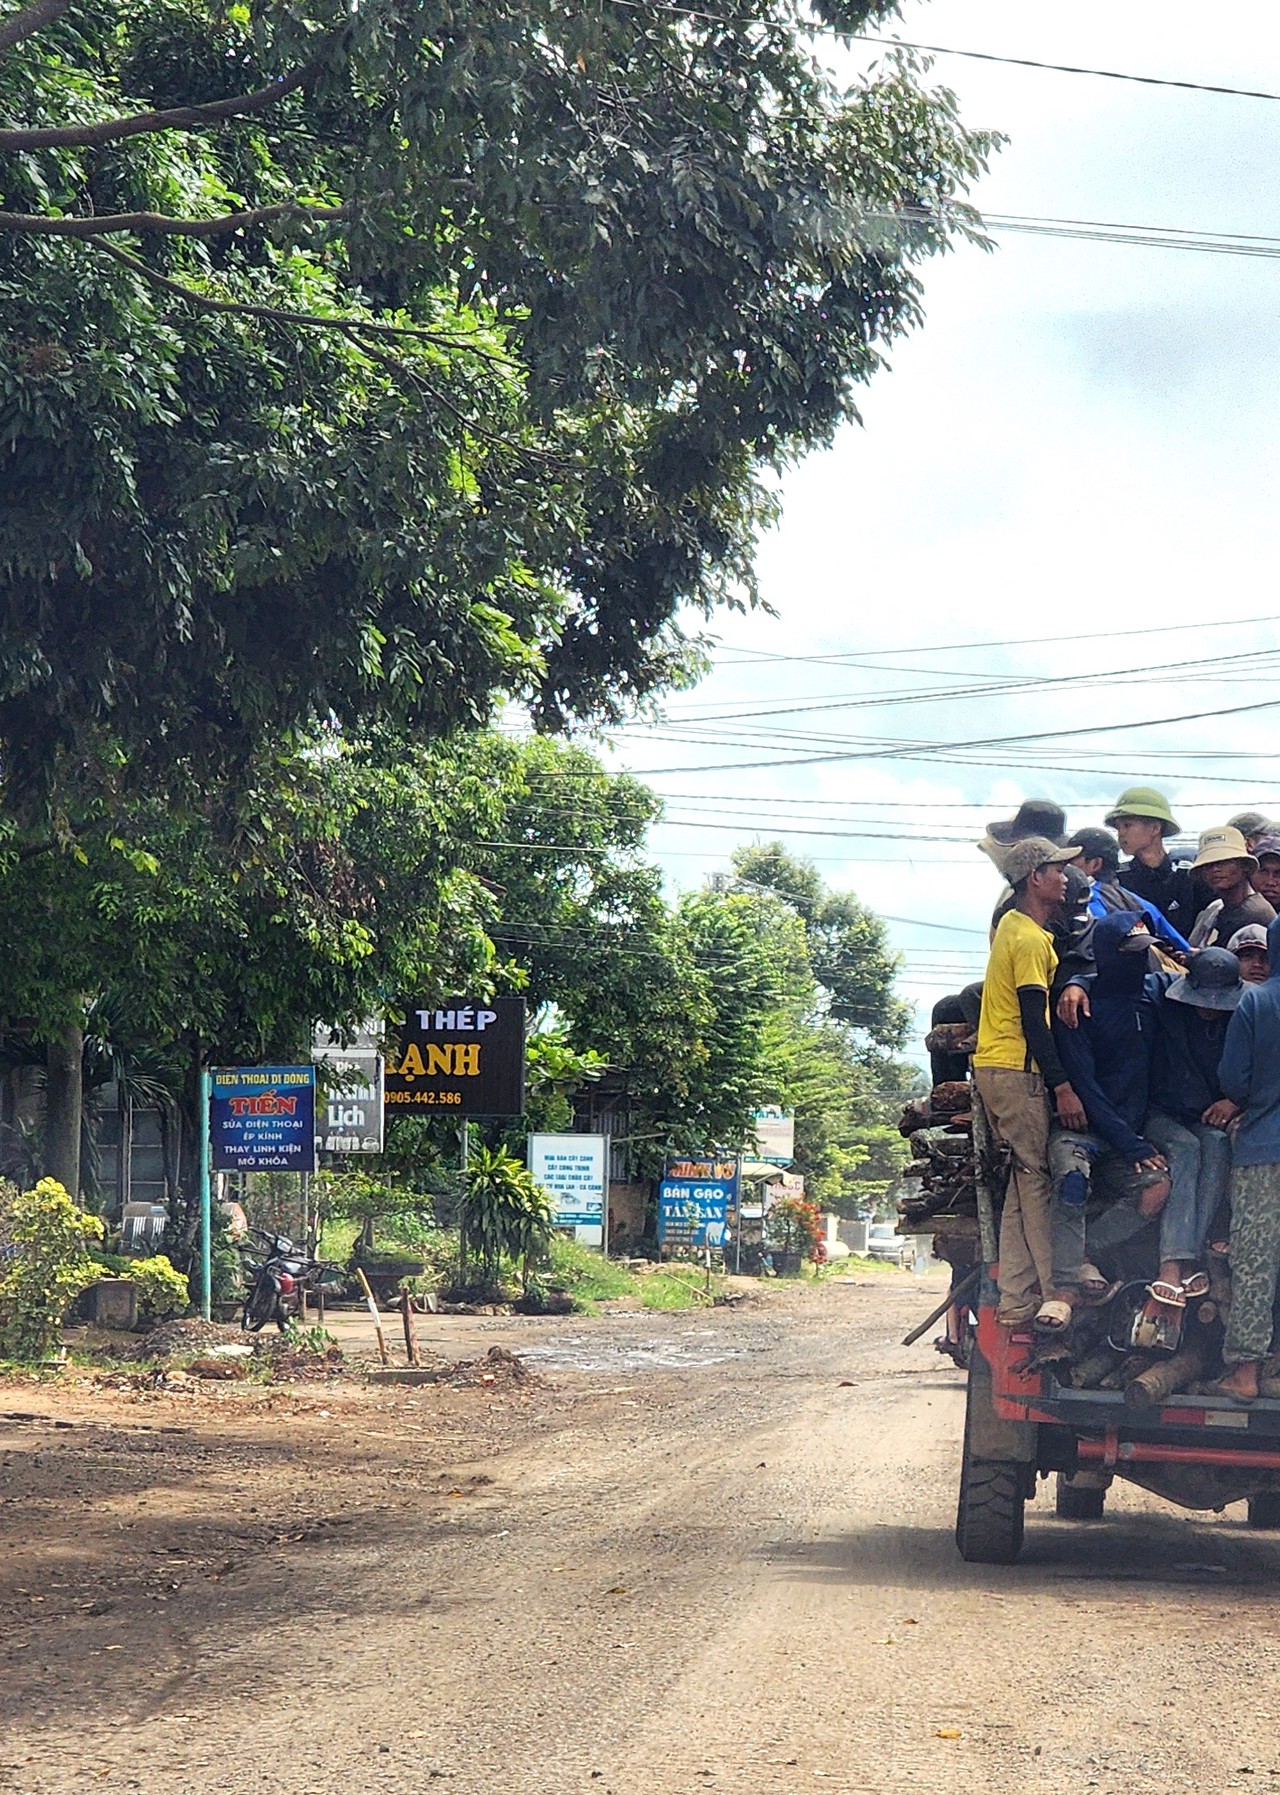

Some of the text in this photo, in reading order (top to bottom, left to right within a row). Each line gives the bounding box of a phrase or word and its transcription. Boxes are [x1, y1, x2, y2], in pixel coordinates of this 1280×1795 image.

[415, 1005, 498, 1030] THÉP
[228, 1089, 298, 1116] TIẾN
[383, 1091, 462, 1104] 0905.442.586
[328, 1104, 365, 1132] Lịch
[272, 1120, 303, 1130] THOẠI
[258, 1131, 283, 1140] KÍNH
[224, 1143, 302, 1155] THAY LINH KIỆN
[258, 1156, 288, 1166] KHÓA
[663, 1184, 724, 1203] BÁN GẠO
